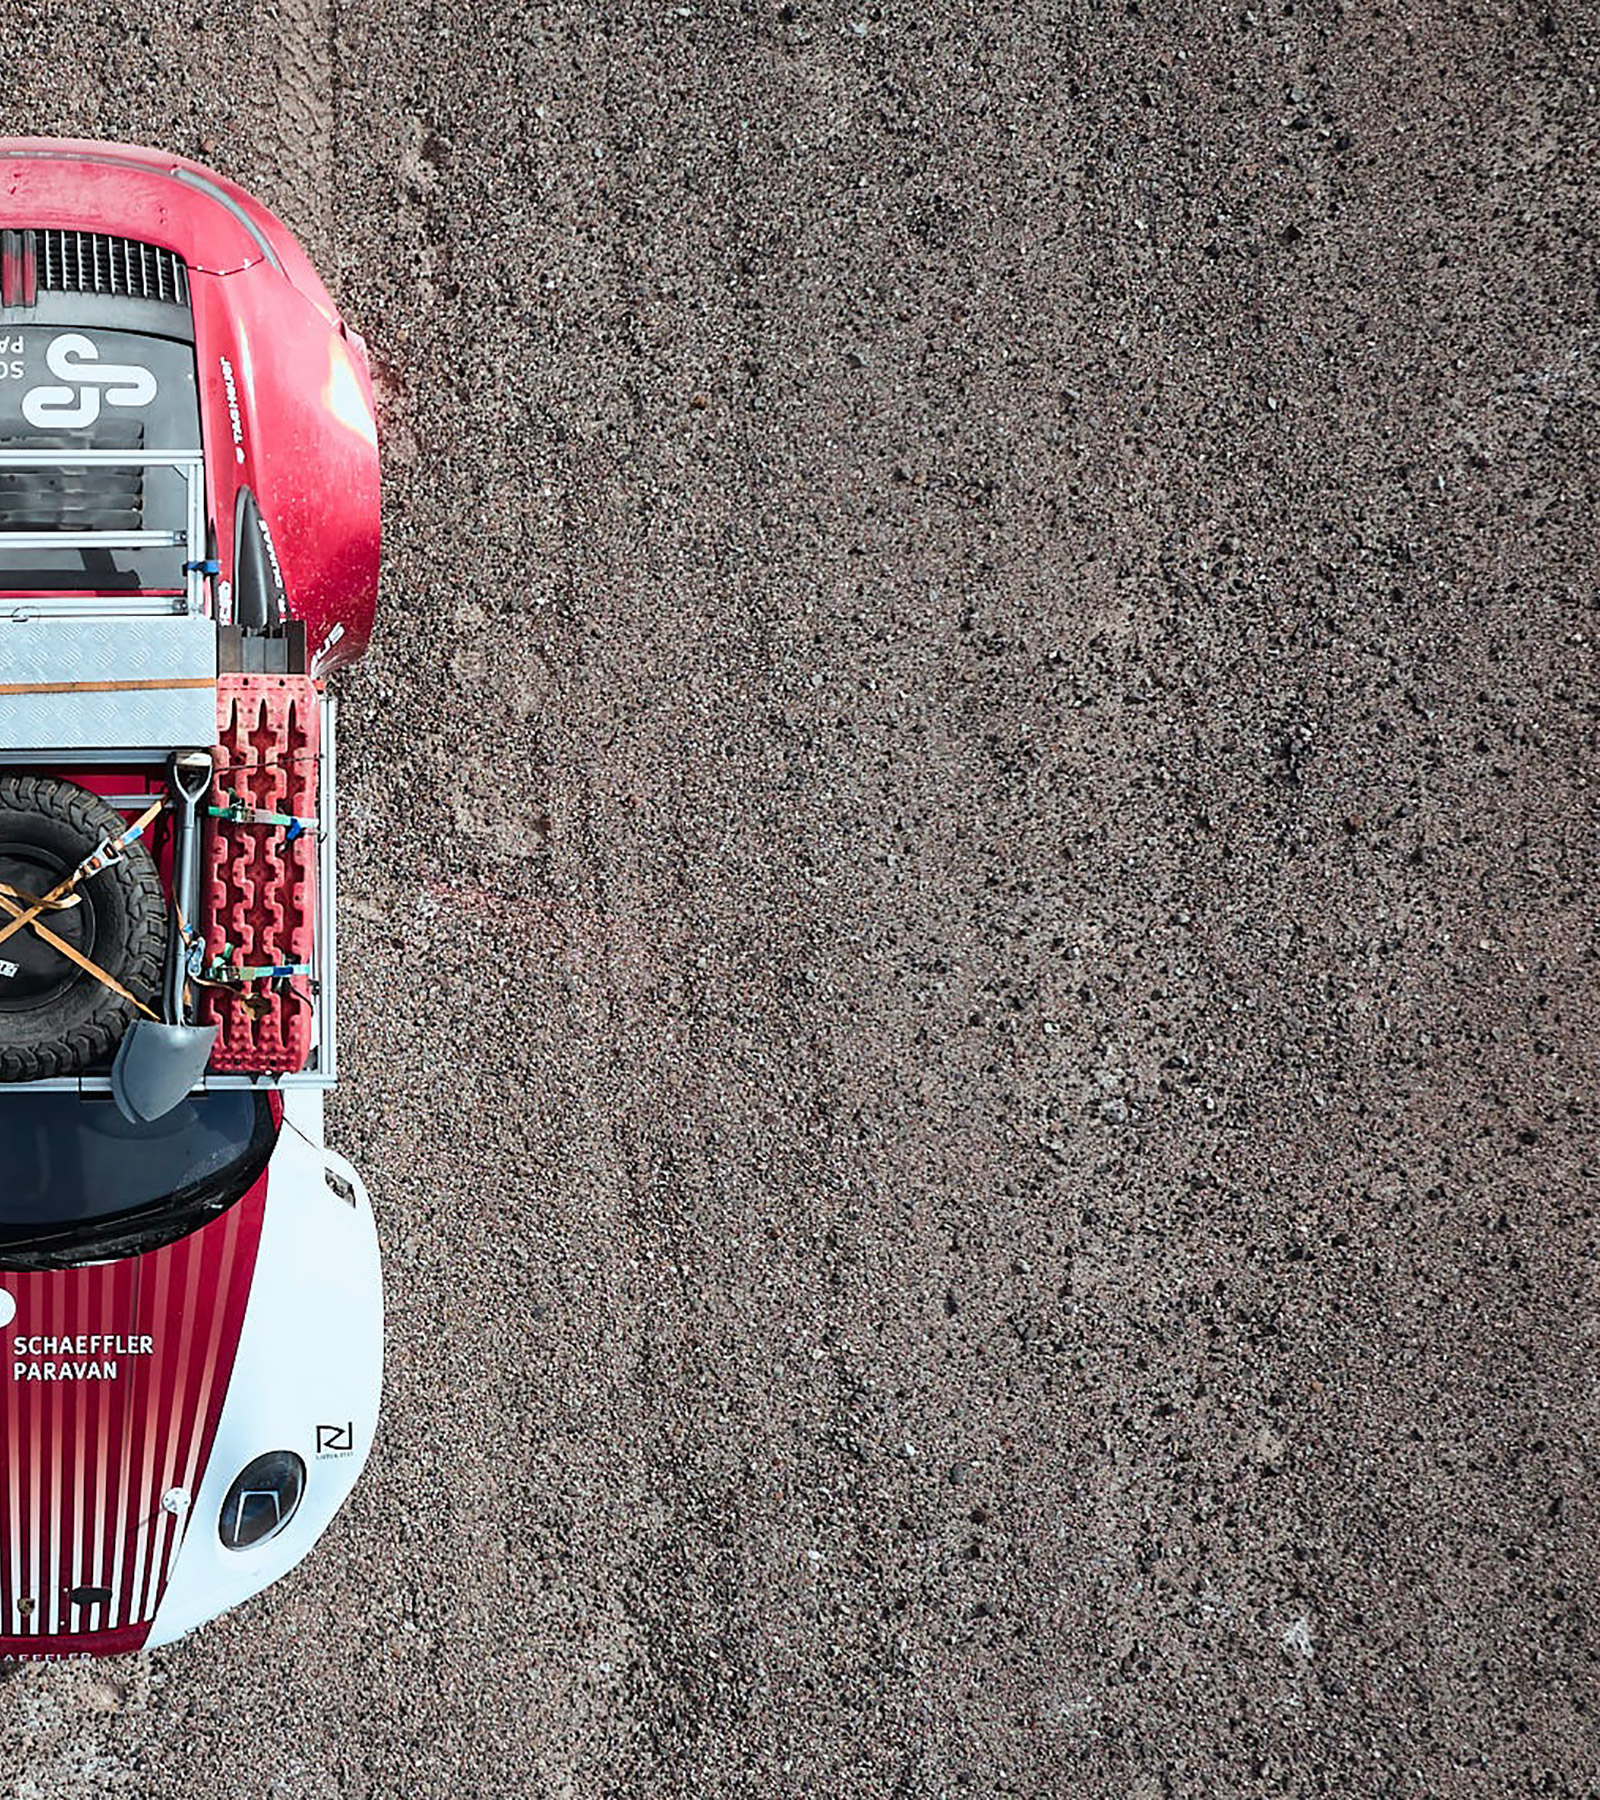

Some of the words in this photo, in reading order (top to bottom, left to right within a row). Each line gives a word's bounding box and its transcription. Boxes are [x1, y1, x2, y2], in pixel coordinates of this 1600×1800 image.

[257, 519, 285, 589] DUMAS
[13, 1335, 154, 1355] SCHAEFFLER
[13, 1361, 118, 1381] PARAVAN
